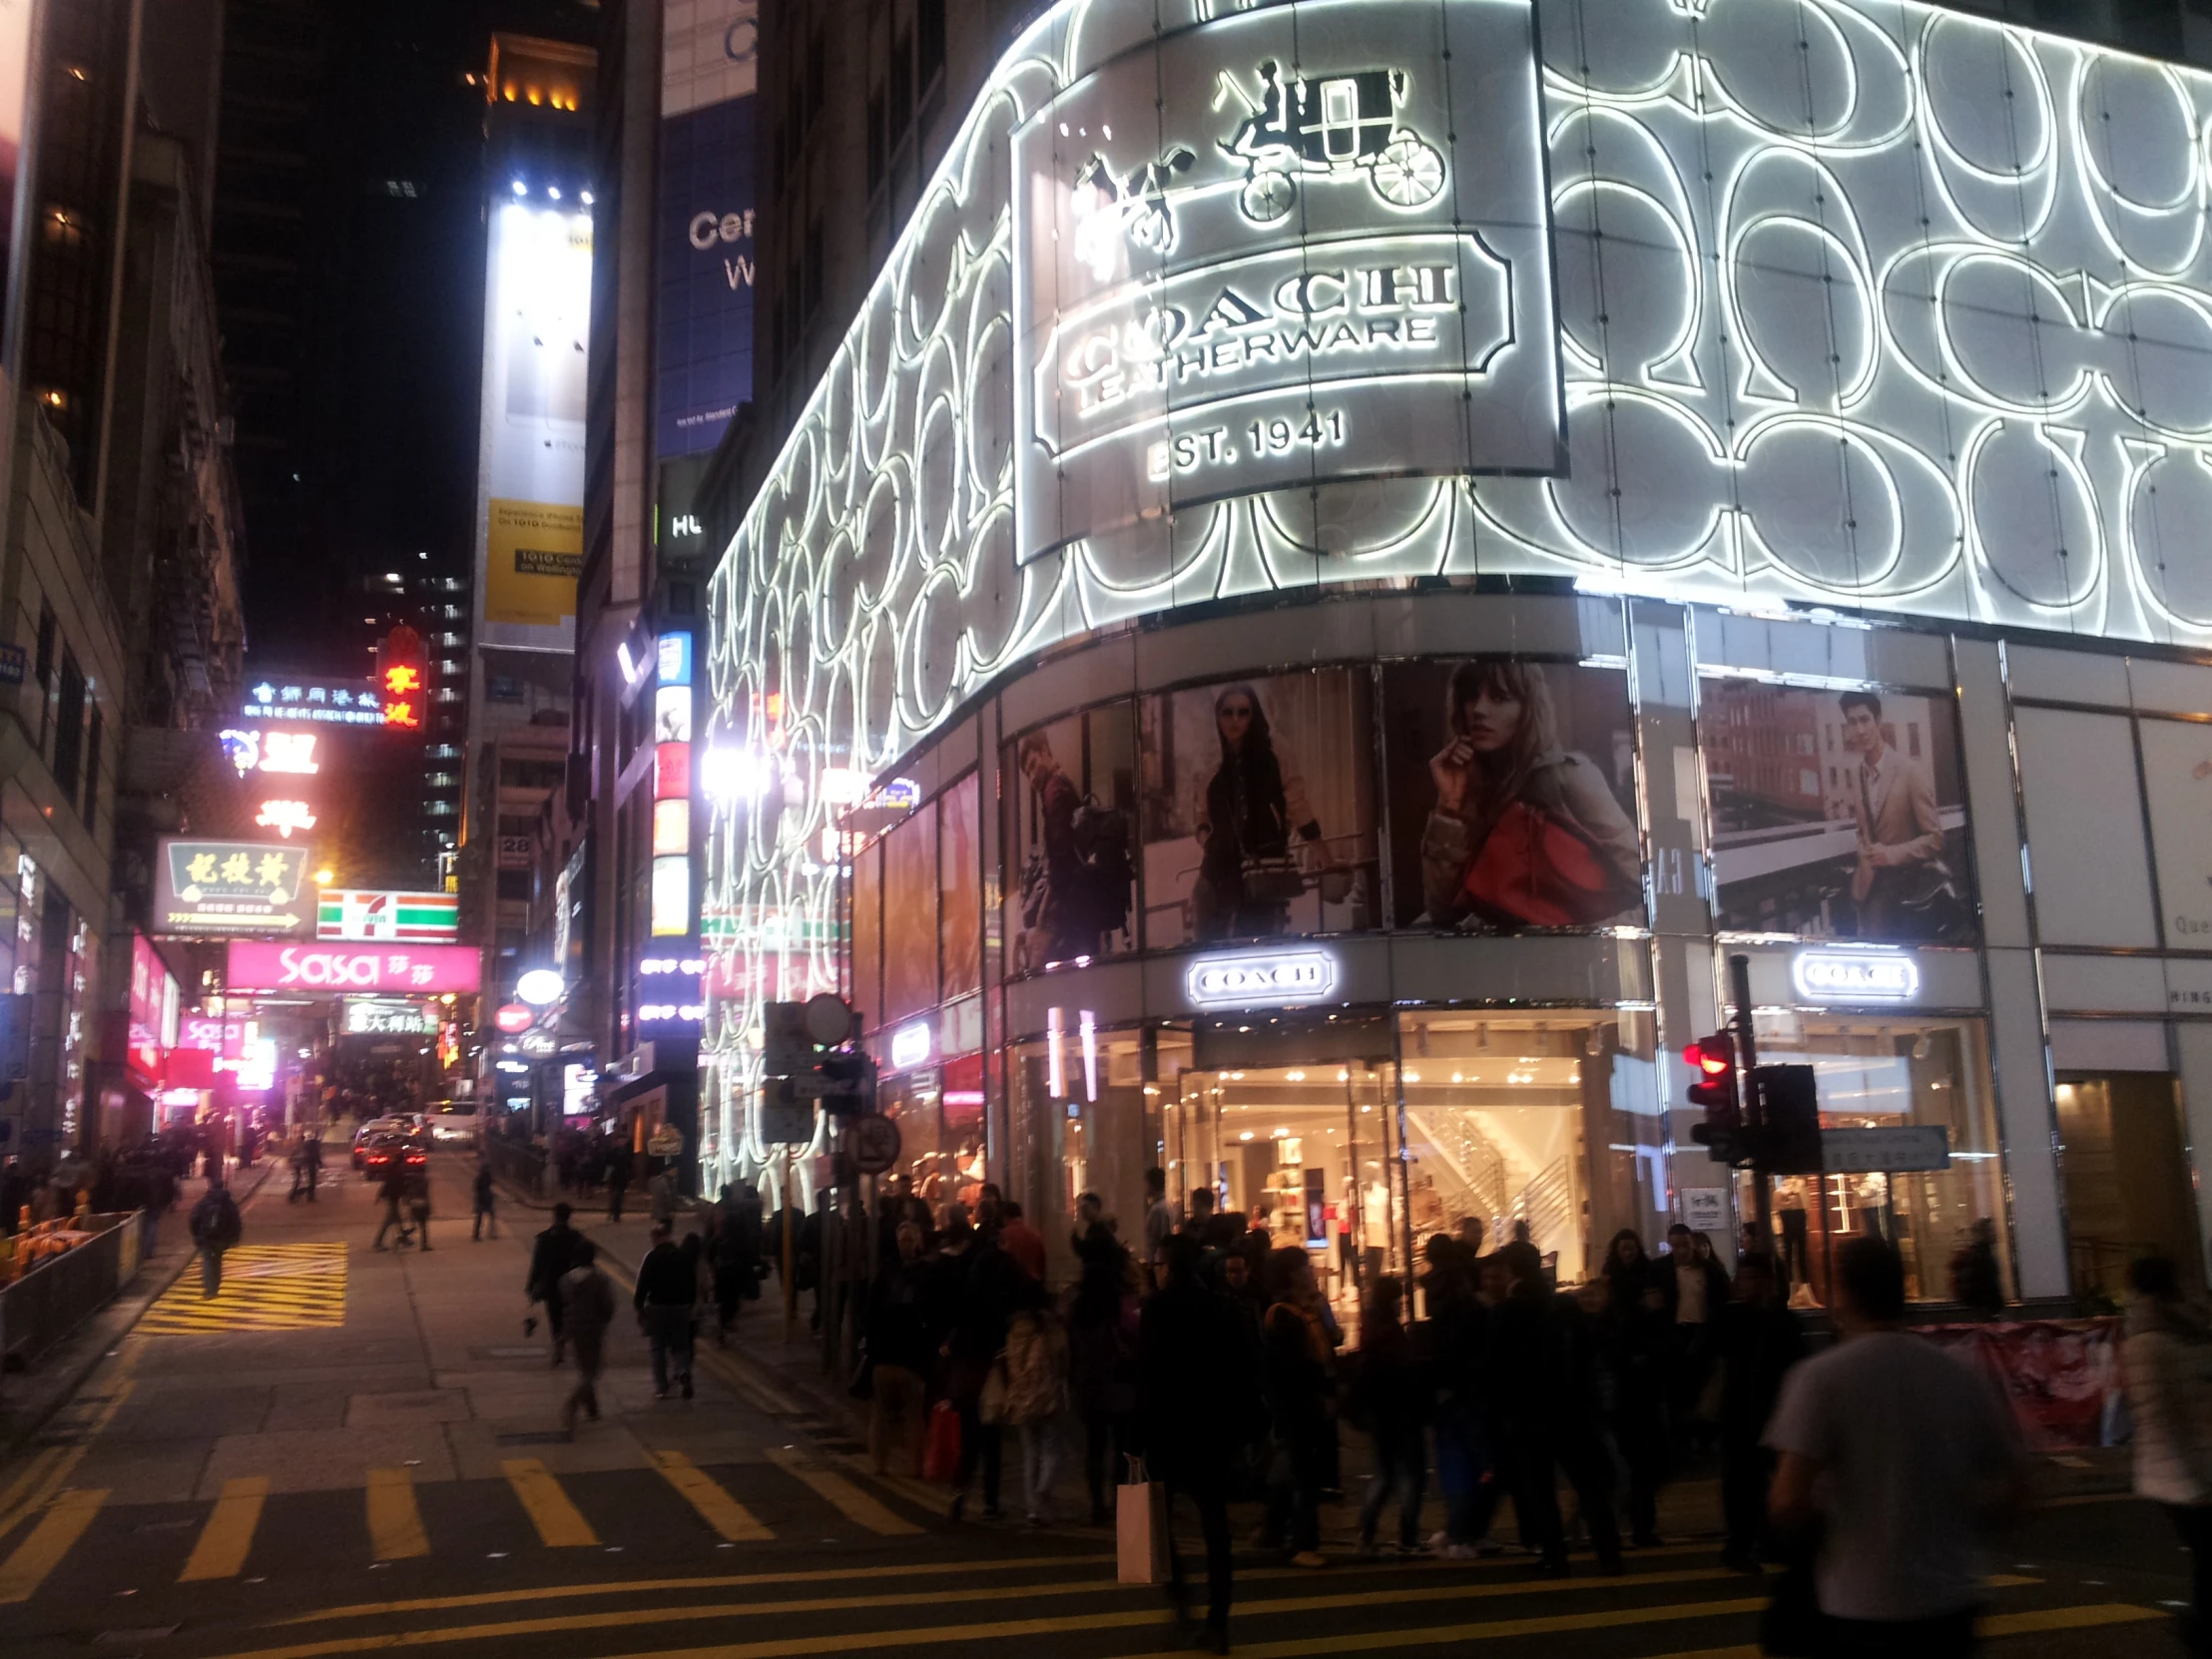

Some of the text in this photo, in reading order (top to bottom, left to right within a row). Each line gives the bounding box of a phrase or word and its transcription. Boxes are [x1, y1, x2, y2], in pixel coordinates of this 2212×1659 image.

[1066, 264, 1455, 387] COACH
[1078, 315, 1439, 419] LEATHERWARE
[1148, 408, 1345, 483] EST. 1941
[1201, 964, 1318, 988] COACH
